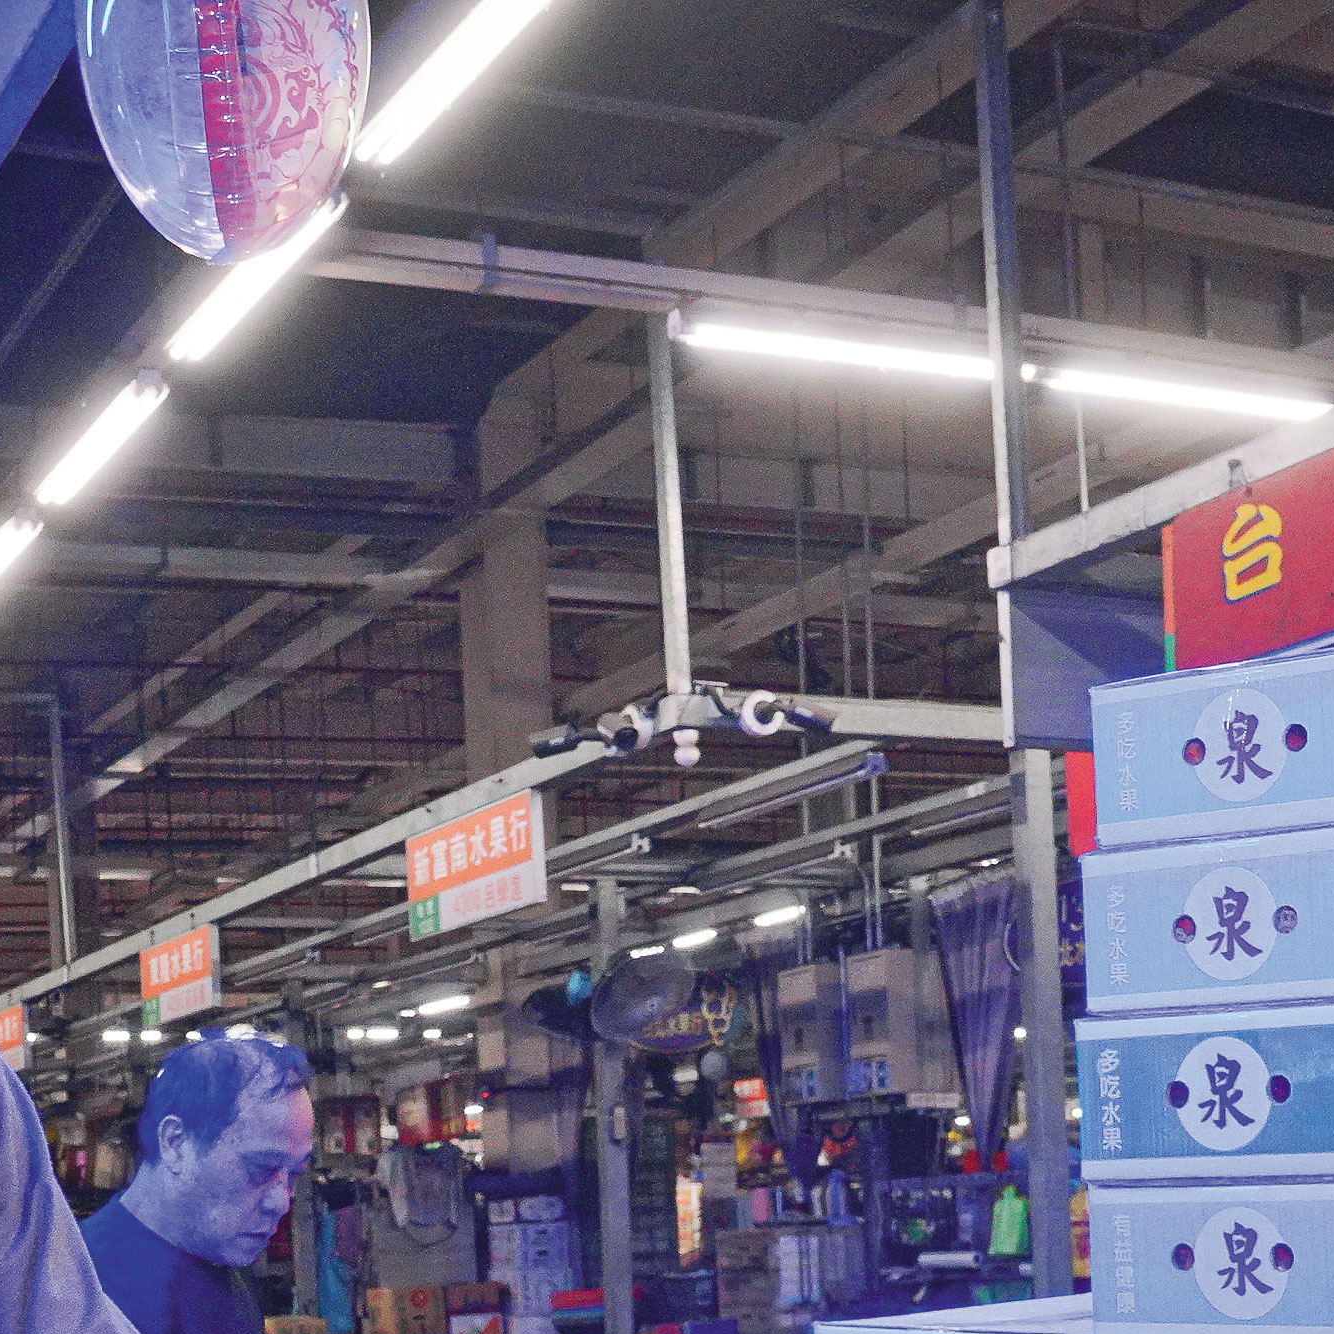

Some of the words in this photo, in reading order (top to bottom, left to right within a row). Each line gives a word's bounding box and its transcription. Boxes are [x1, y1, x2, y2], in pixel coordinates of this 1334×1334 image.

[1222, 503, 1284, 603] 台
[1114, 711, 1140, 811] 多吃水果
[1216, 709, 1273, 784] 泉
[1105, 884, 1130, 986] 多吃水果
[1205, 885, 1264, 961] 泉
[1097, 1048, 1123, 1152] 多吃水果
[1197, 1052, 1256, 1130] 泉
[1218, 1221, 1275, 1297] 泉
